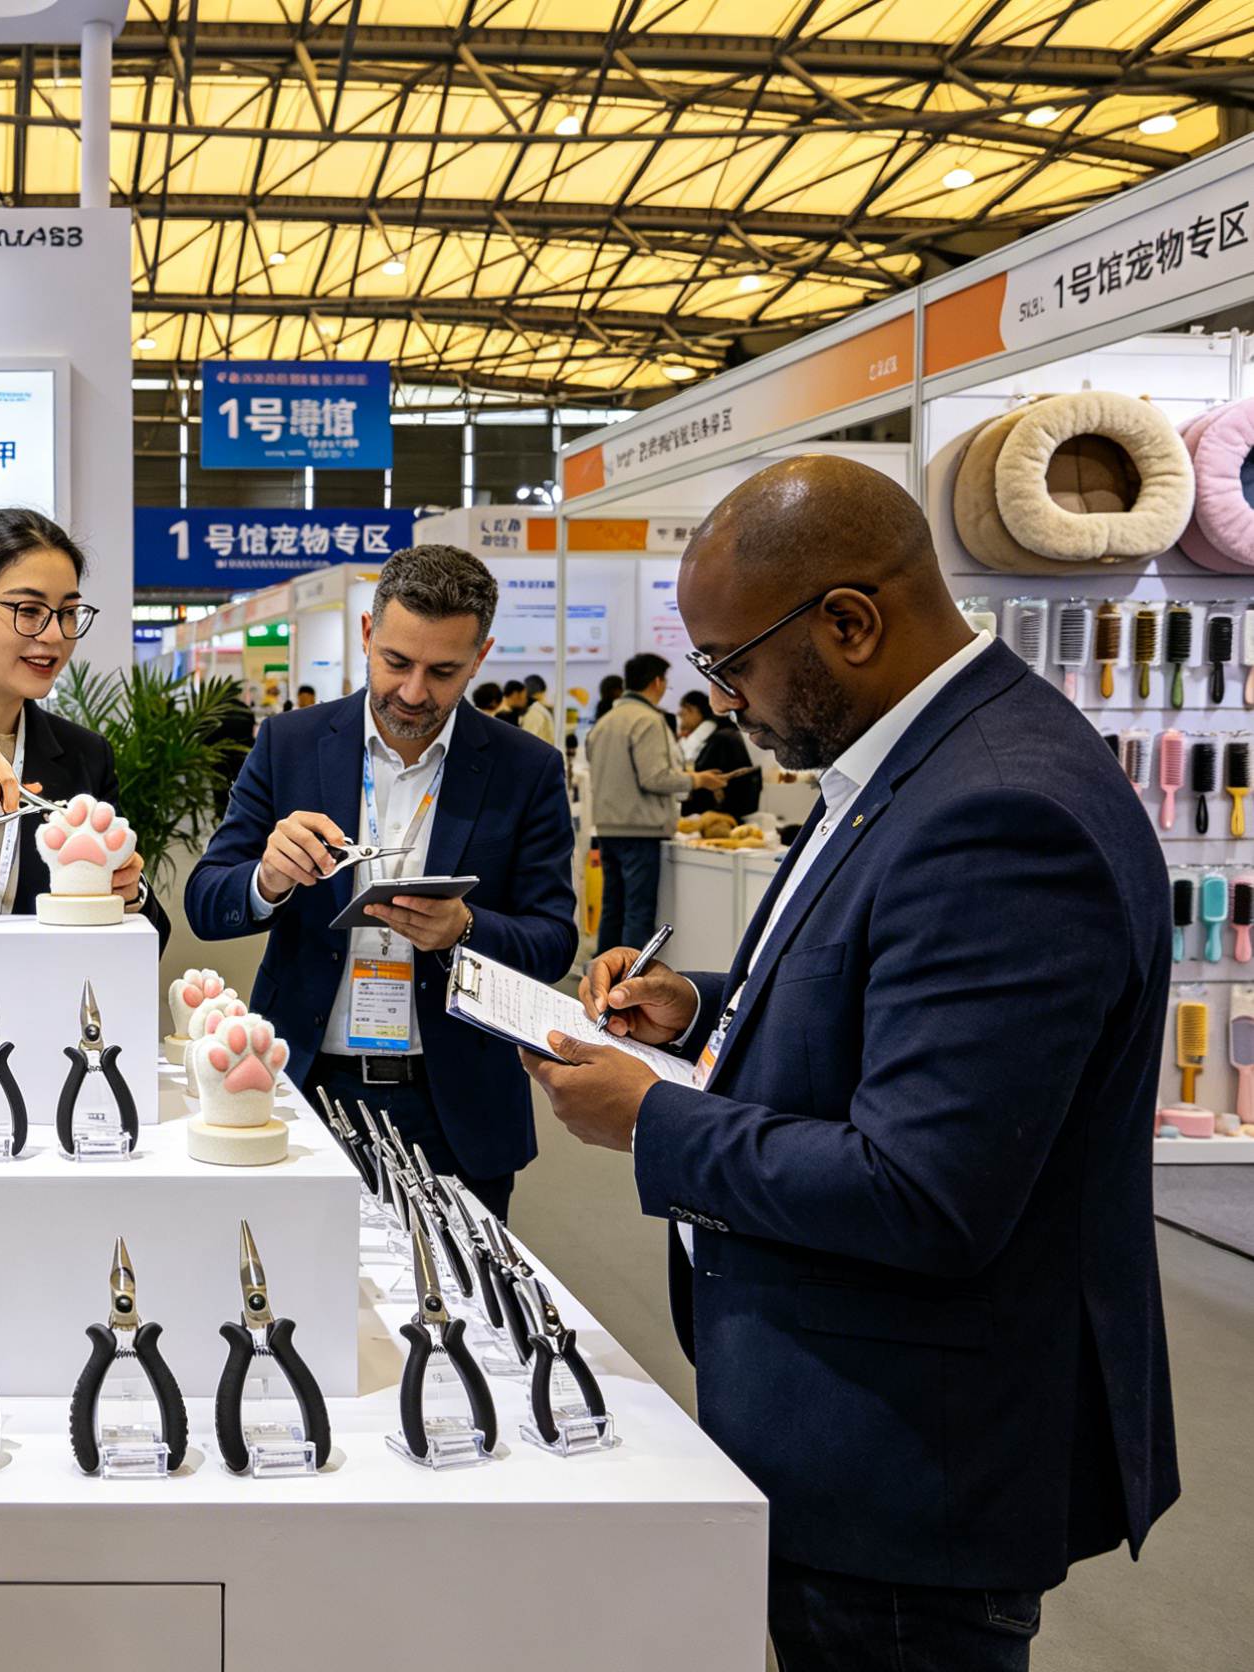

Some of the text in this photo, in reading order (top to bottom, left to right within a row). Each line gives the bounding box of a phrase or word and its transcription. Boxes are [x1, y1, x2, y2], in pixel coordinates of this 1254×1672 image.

[1053, 201, 1250, 309] 1号馆宠物专区
